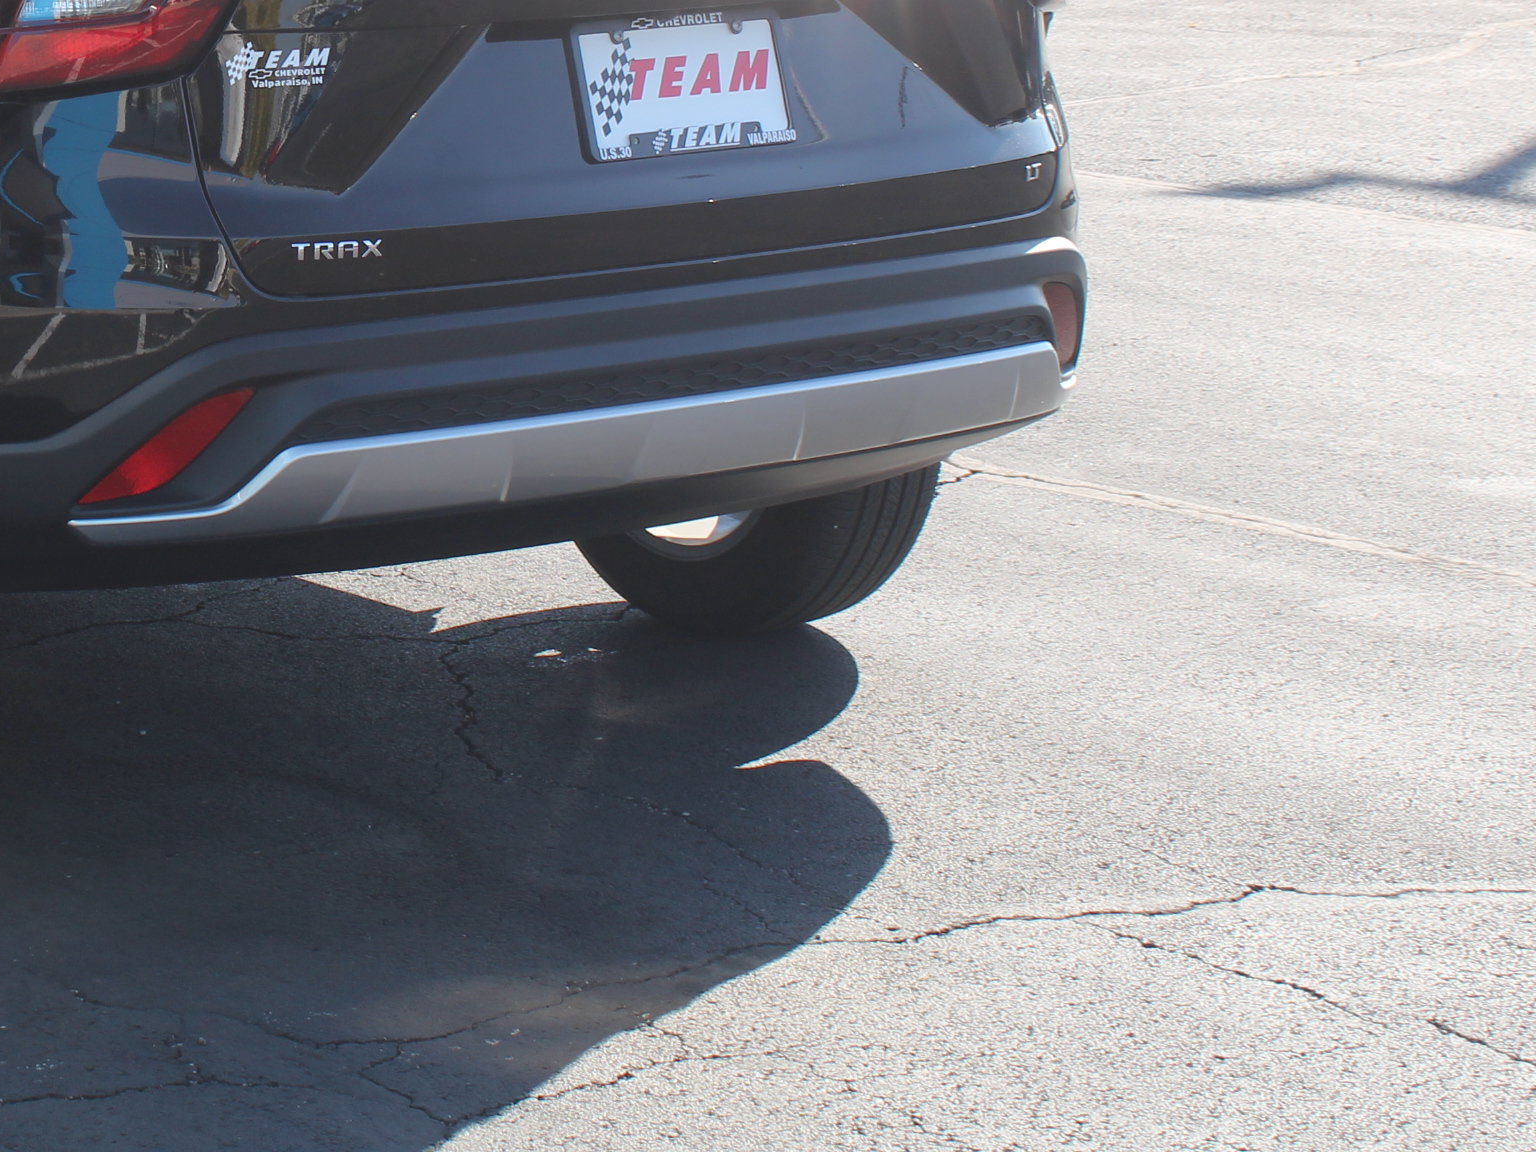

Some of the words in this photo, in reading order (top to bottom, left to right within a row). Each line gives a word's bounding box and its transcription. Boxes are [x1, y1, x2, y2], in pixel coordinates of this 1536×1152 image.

[249, 47, 331, 70] TEAM
[251, 78, 311, 89] Valparaiso,
[311, 75, 324, 85] IN
[274, 67, 326, 78] CHEVROLET
[629, 48, 770, 101] TEAM
[670, 121, 741, 150] TEAM
[747, 128, 797, 147] VALPARAISO
[1025, 162, 1043, 182] LT
[291, 239, 383, 262] TRAX
